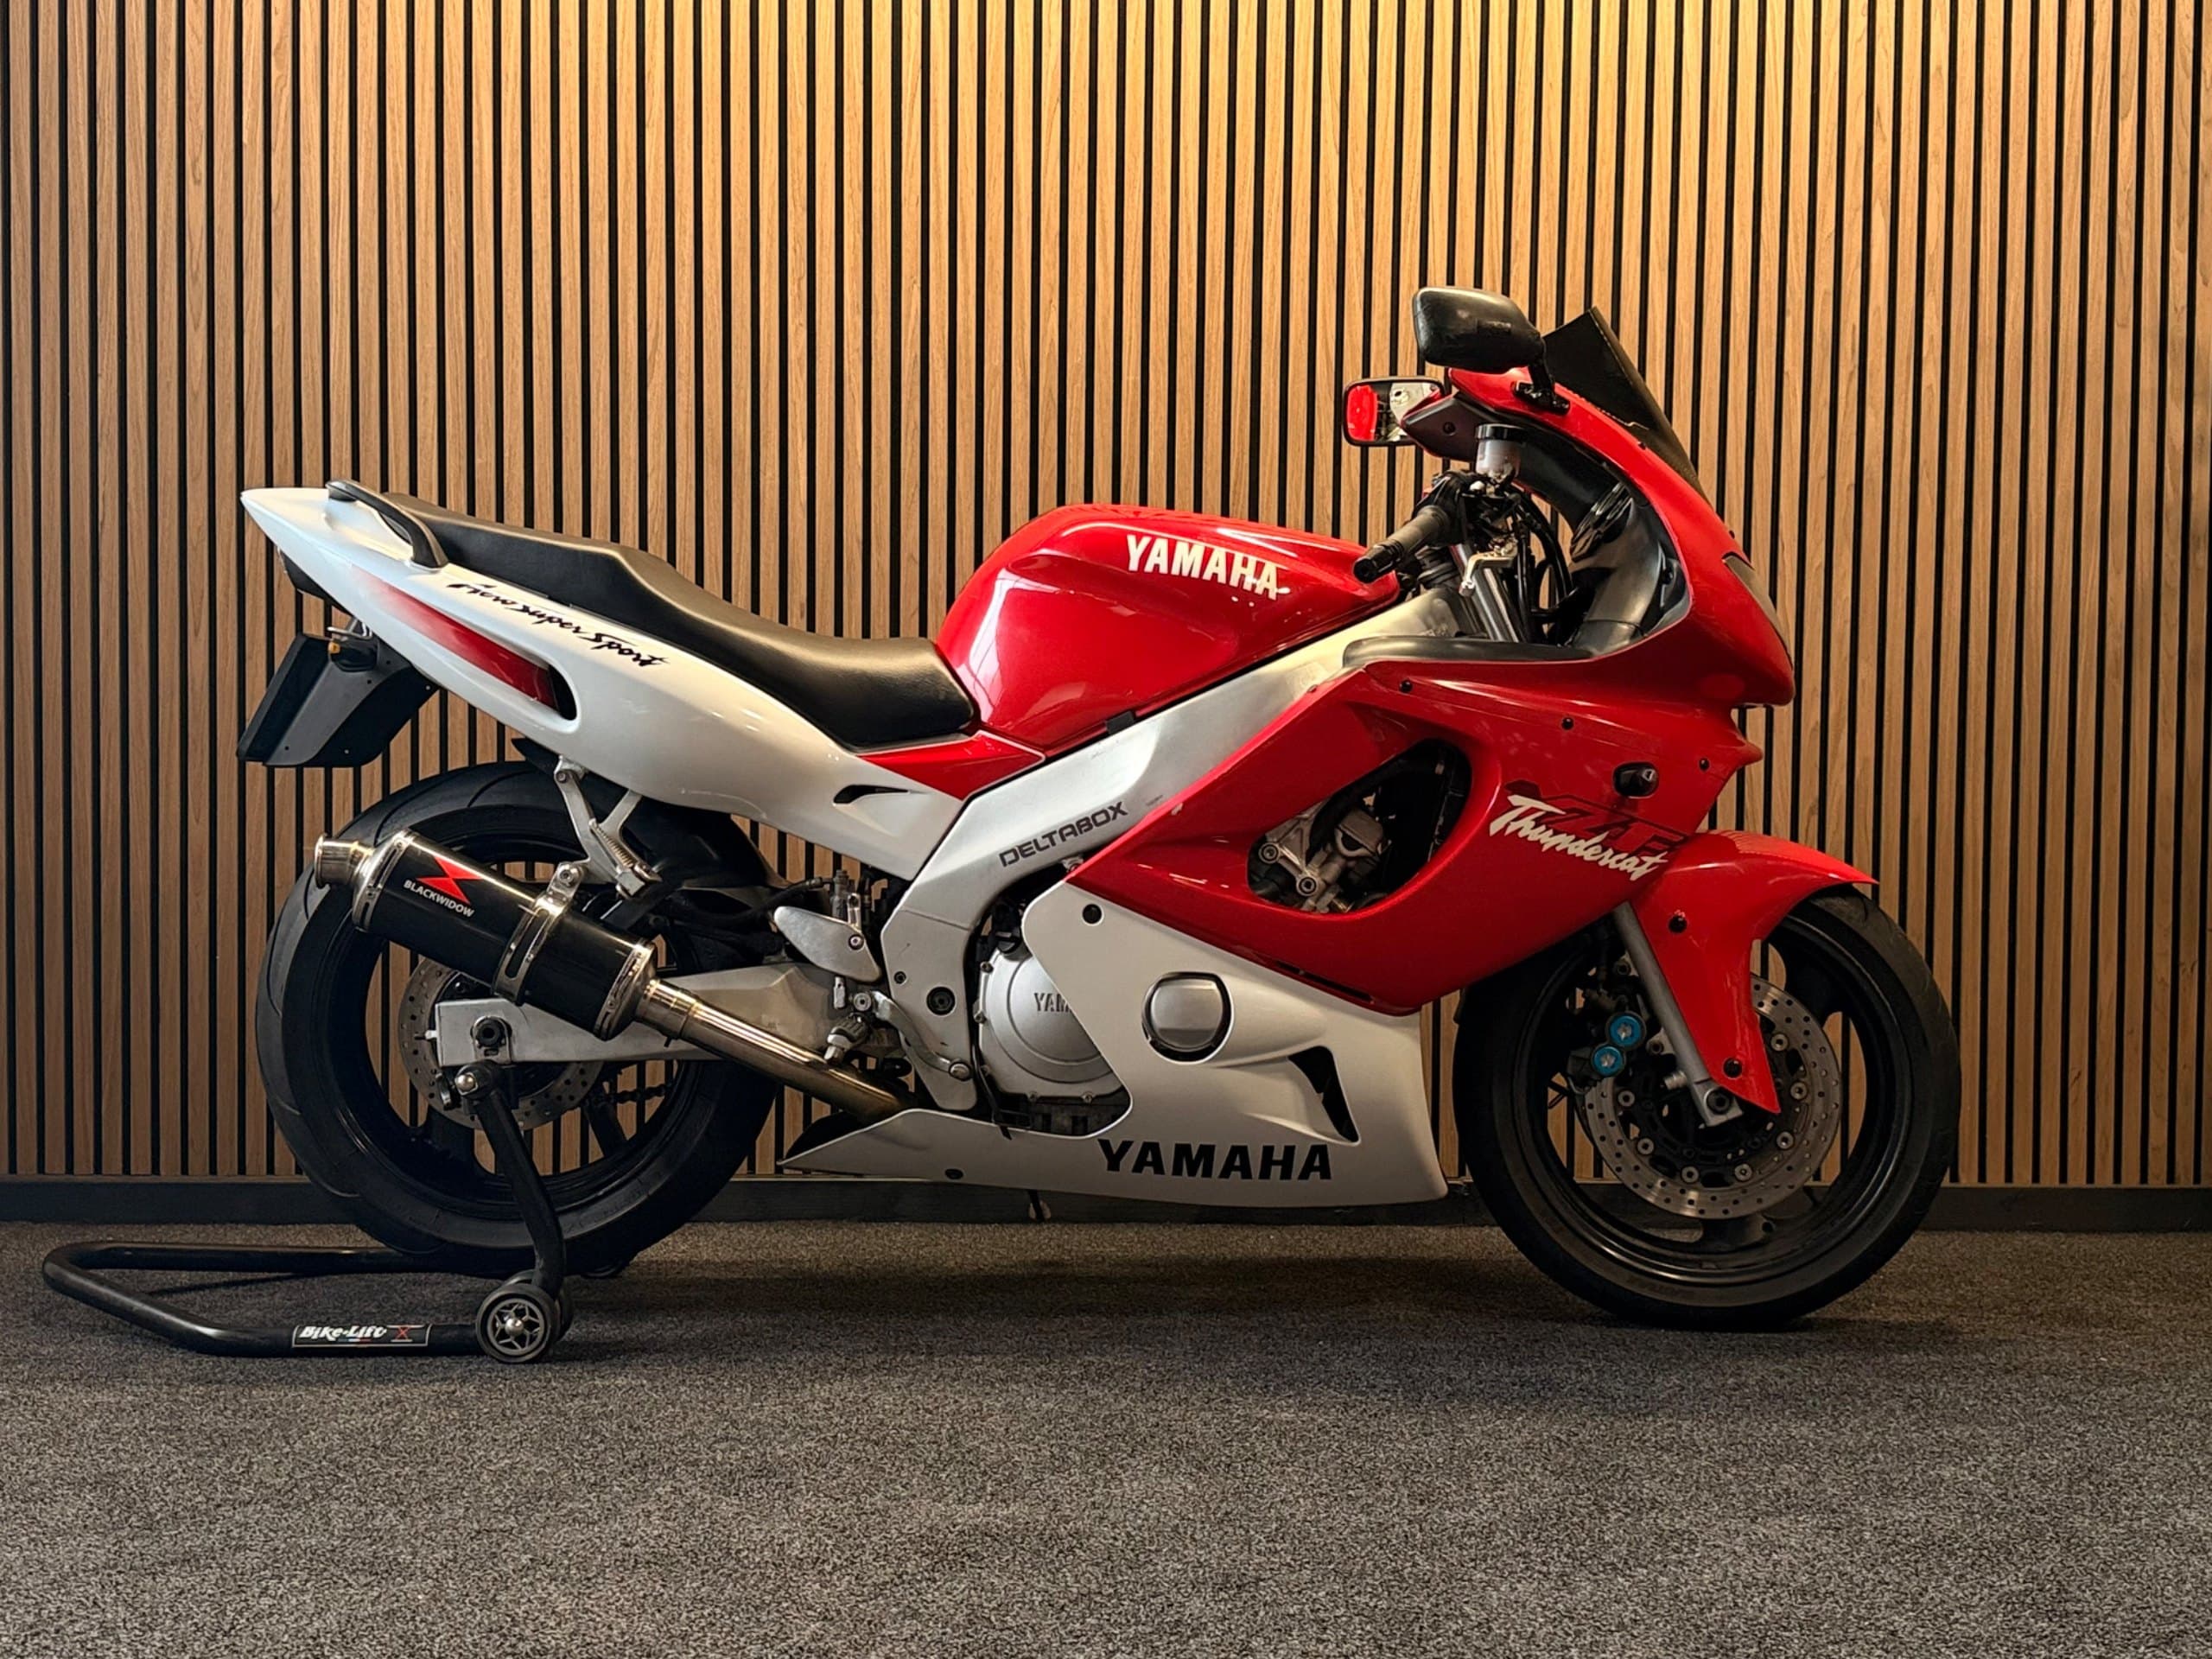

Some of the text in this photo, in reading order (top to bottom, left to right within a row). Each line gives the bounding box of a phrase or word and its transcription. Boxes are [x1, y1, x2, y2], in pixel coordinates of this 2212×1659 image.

[1127, 535, 1277, 600] YAMAHA
[999, 801, 1128, 868] DELTABOX
[1489, 794, 1669, 880] Thundercat
[403, 880, 475, 918] BLACKWIDOW
[1097, 1138, 1332, 1180] YAMAHA
